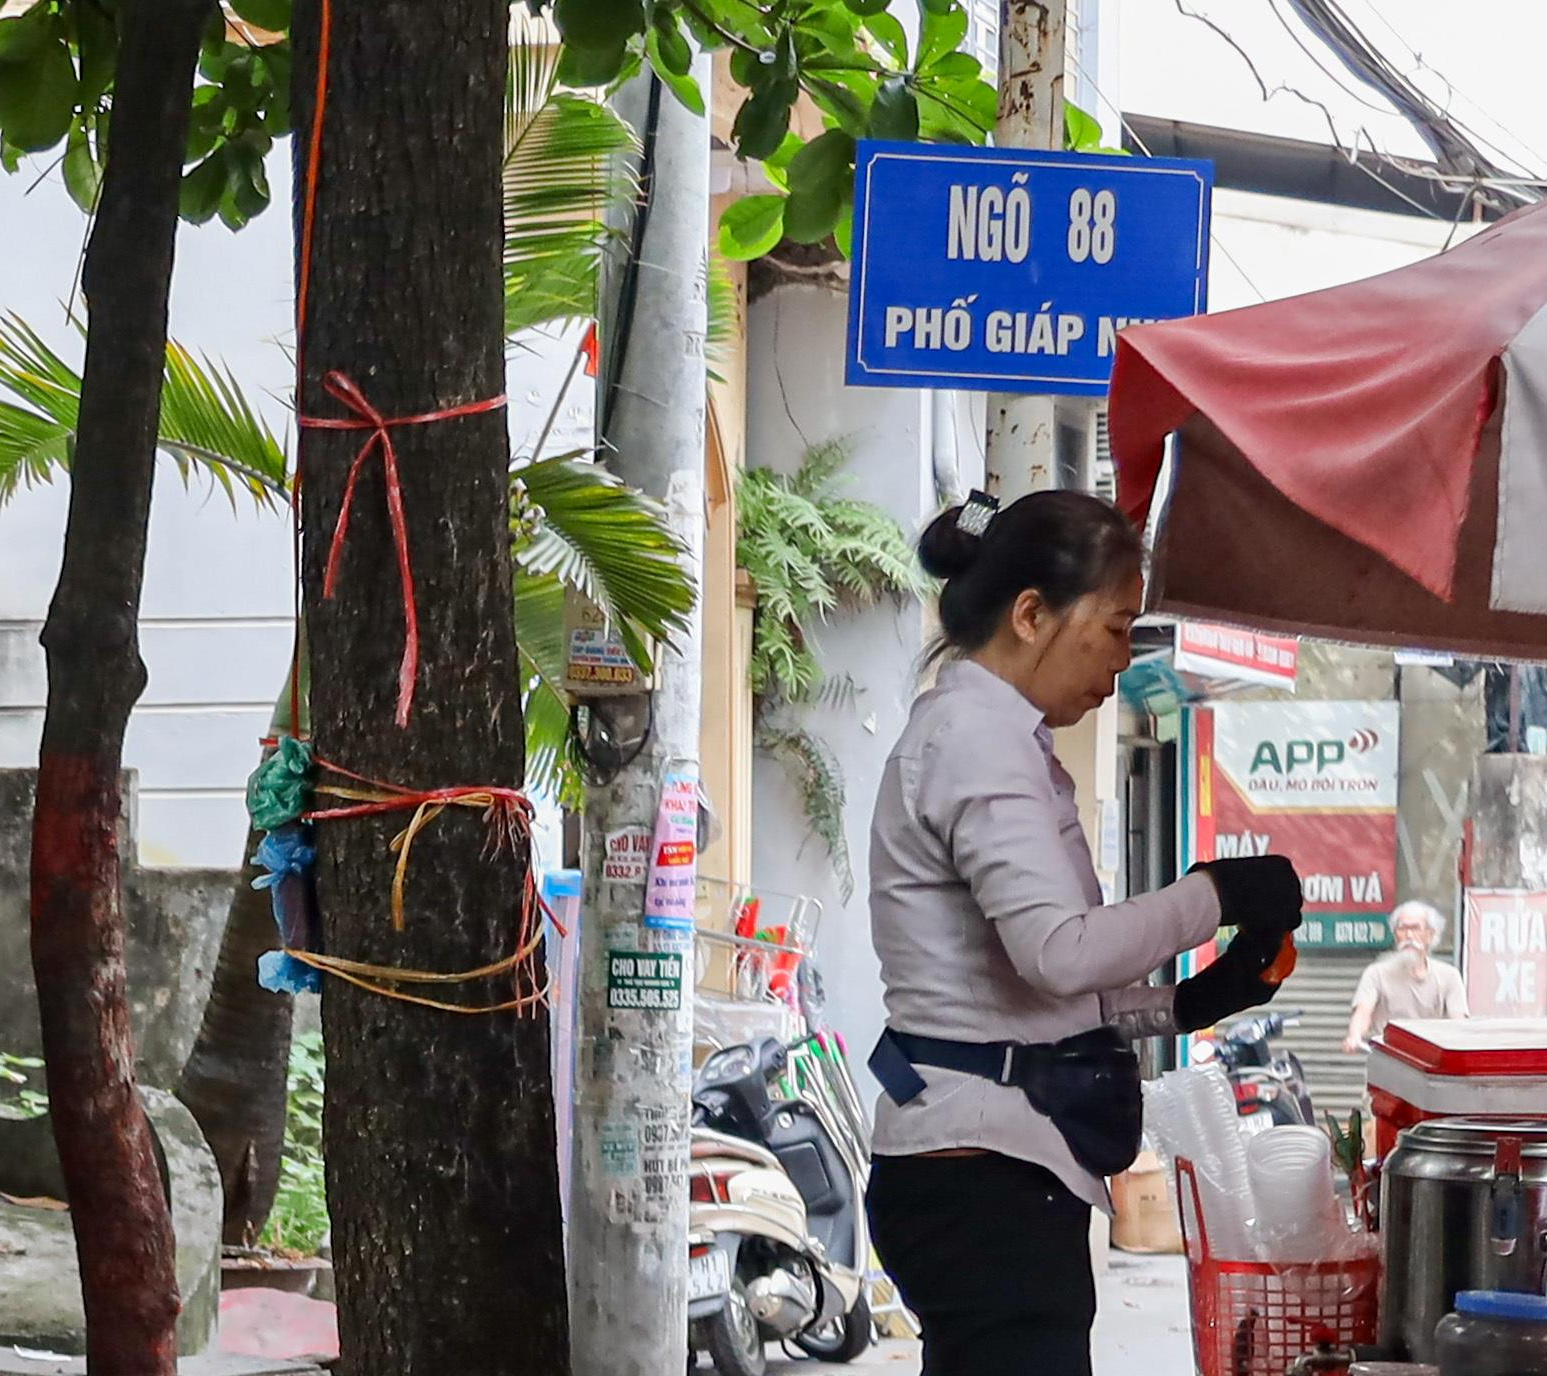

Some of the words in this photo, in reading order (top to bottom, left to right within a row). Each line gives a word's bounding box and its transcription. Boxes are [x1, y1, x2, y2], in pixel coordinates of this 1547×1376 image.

[946, 171, 1031, 264] NGÕ
[1066, 187, 1116, 264] 88
[884, 293, 979, 351] PHỐ
[985, 301, 1084, 356] GIÁP
[1249, 740, 1345, 775] APP
[1301, 873, 1345, 903] ƠM
[611, 957, 635, 977] CHO
[636, 958, 658, 978] VAY
[1495, 960, 1536, 1003] XE
